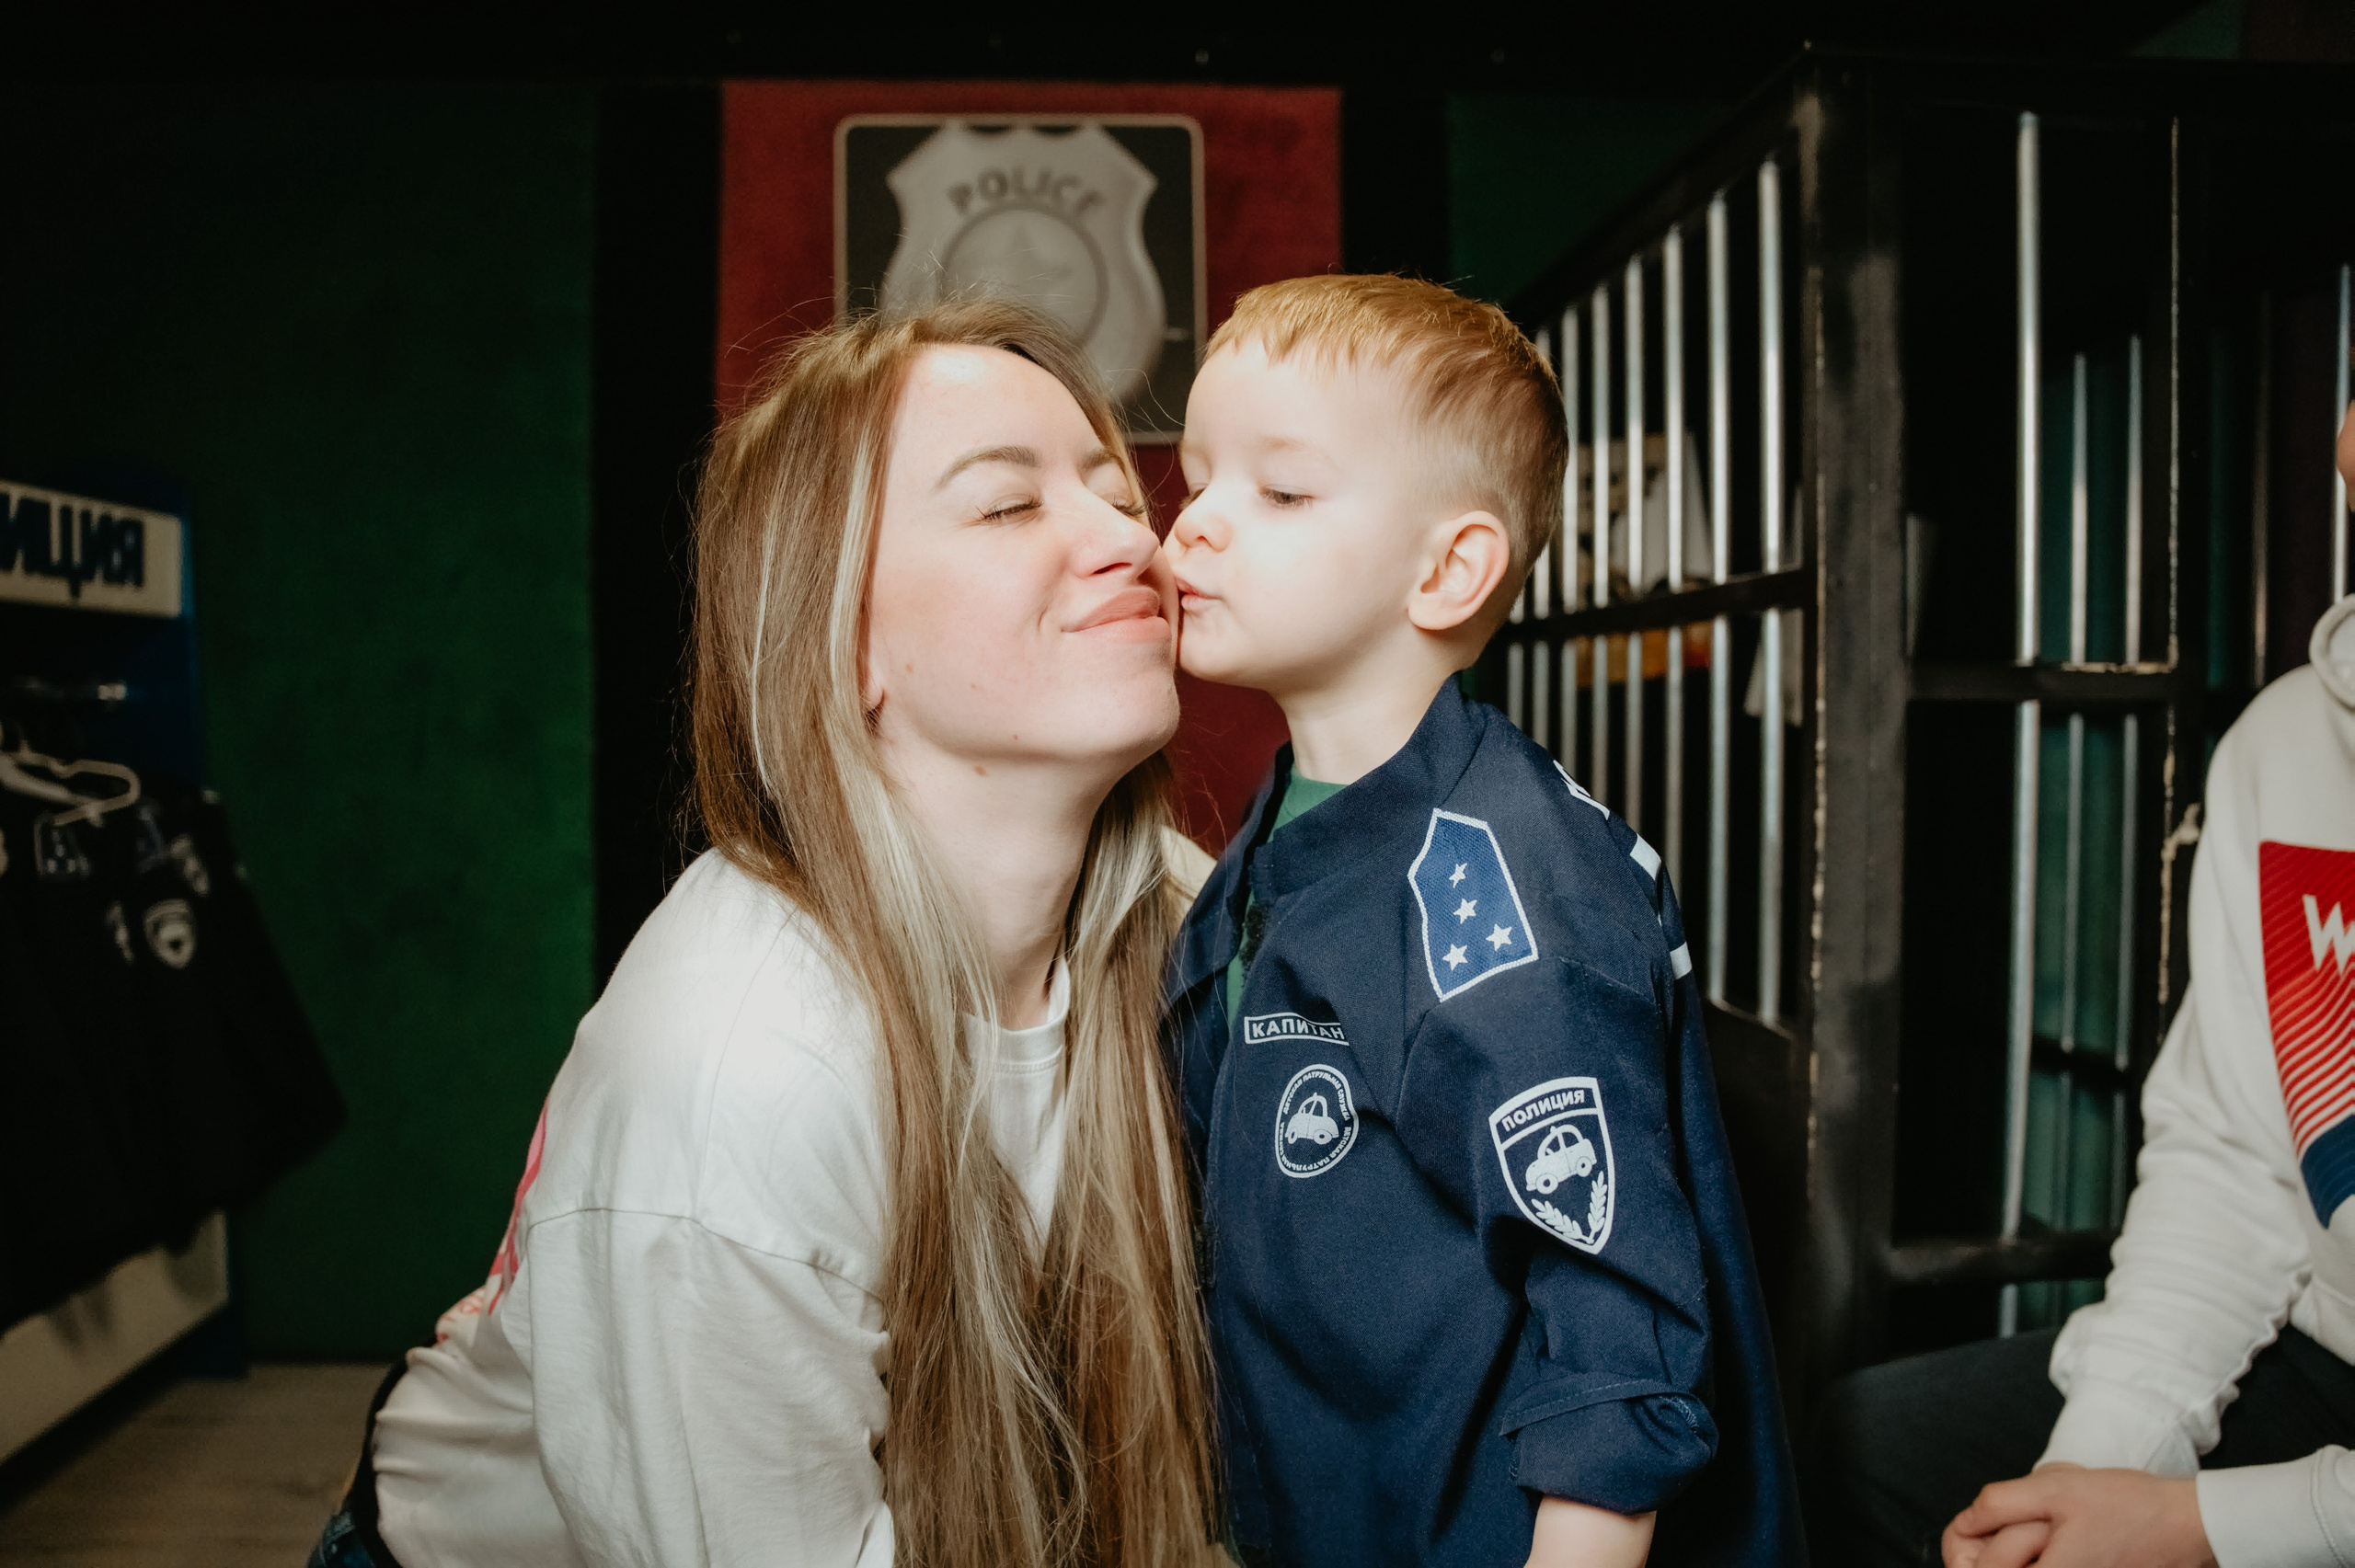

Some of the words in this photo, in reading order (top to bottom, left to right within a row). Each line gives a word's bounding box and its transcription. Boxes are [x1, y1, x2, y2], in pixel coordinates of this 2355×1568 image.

[1251, 1017, 1346, 1040] КАПИТАН
[1303, 1070, 1342, 1090] ПАТРУЛЬНАЯ
[1501, 1089, 1585, 1132] ПОЛИЦИЯ
